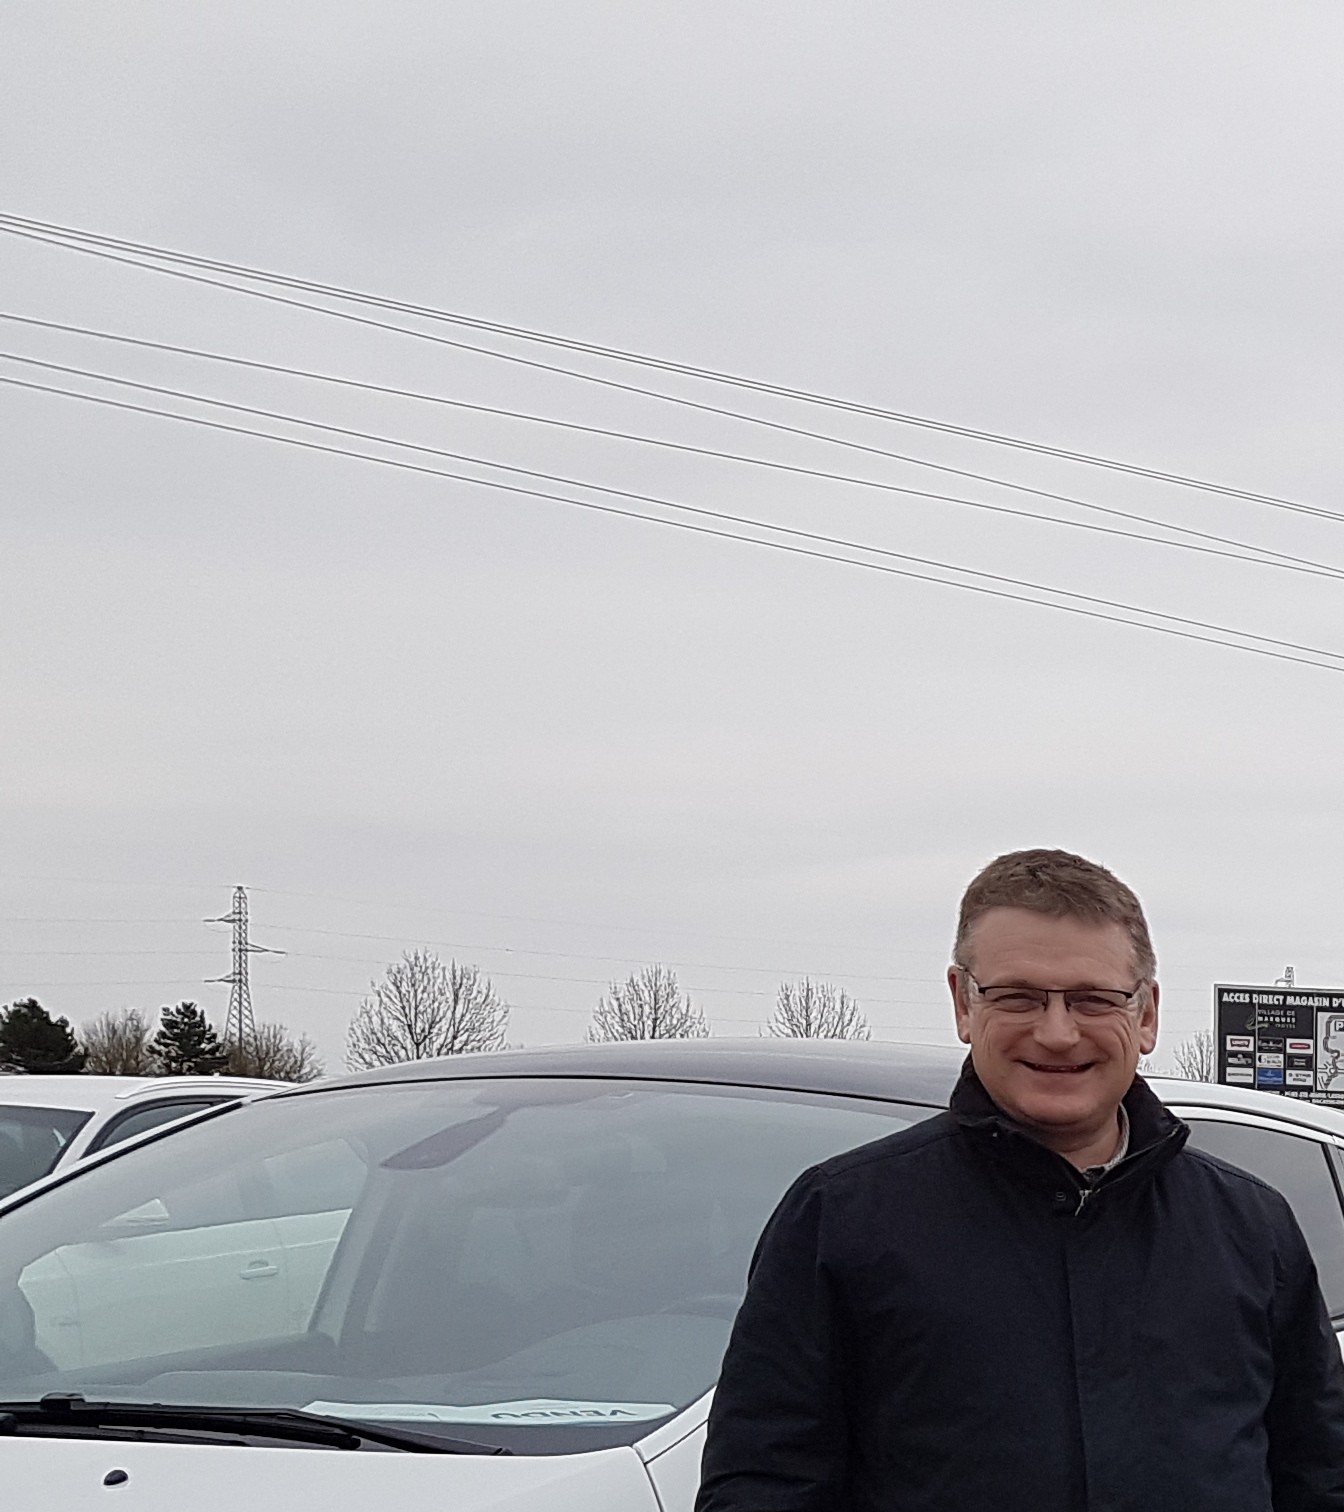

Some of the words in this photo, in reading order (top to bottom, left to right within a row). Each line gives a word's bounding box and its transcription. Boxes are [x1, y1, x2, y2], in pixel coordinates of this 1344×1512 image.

[1222, 992, 1250, 1003] ACCES
[1252, 993, 1284, 1005] DIRECT
[1286, 995, 1329, 1007] MAGASIN
[1336, 1021, 1344, 1031] P
[491, 1409, 637, 1419] VENDU
